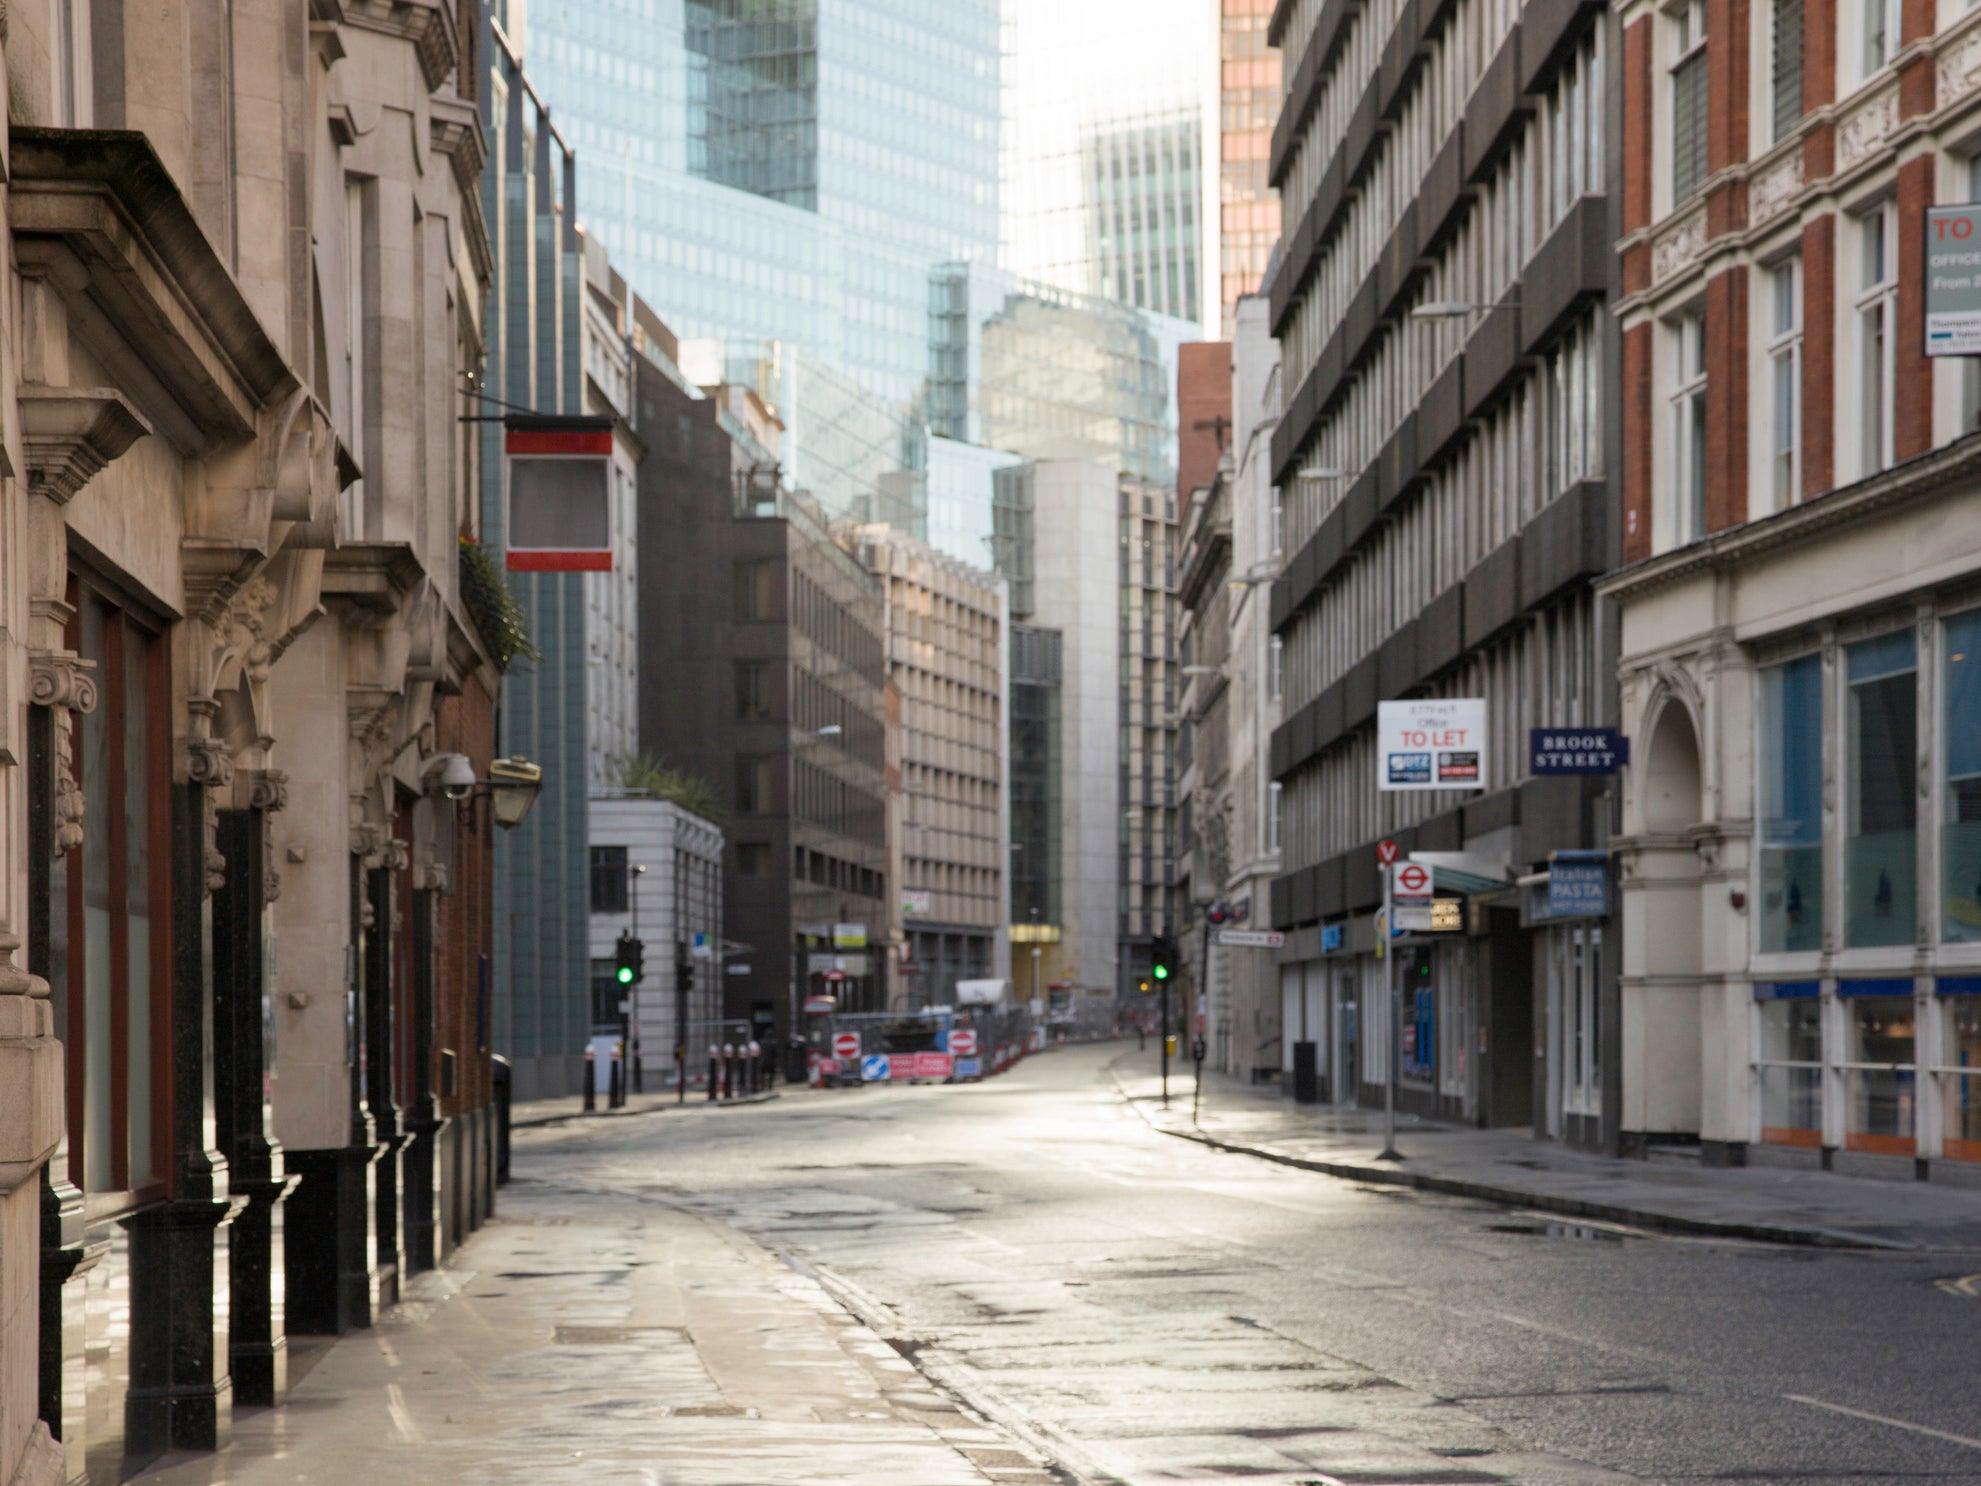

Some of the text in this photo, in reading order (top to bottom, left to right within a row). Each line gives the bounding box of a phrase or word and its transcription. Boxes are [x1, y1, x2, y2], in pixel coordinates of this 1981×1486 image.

[1932, 216, 1973, 241] TO
[1401, 729, 1466, 747] TO LET
[1543, 735, 1607, 750] BROOK
[1535, 752, 1615, 767] STREET
[1551, 883, 1603, 897] PASTA
